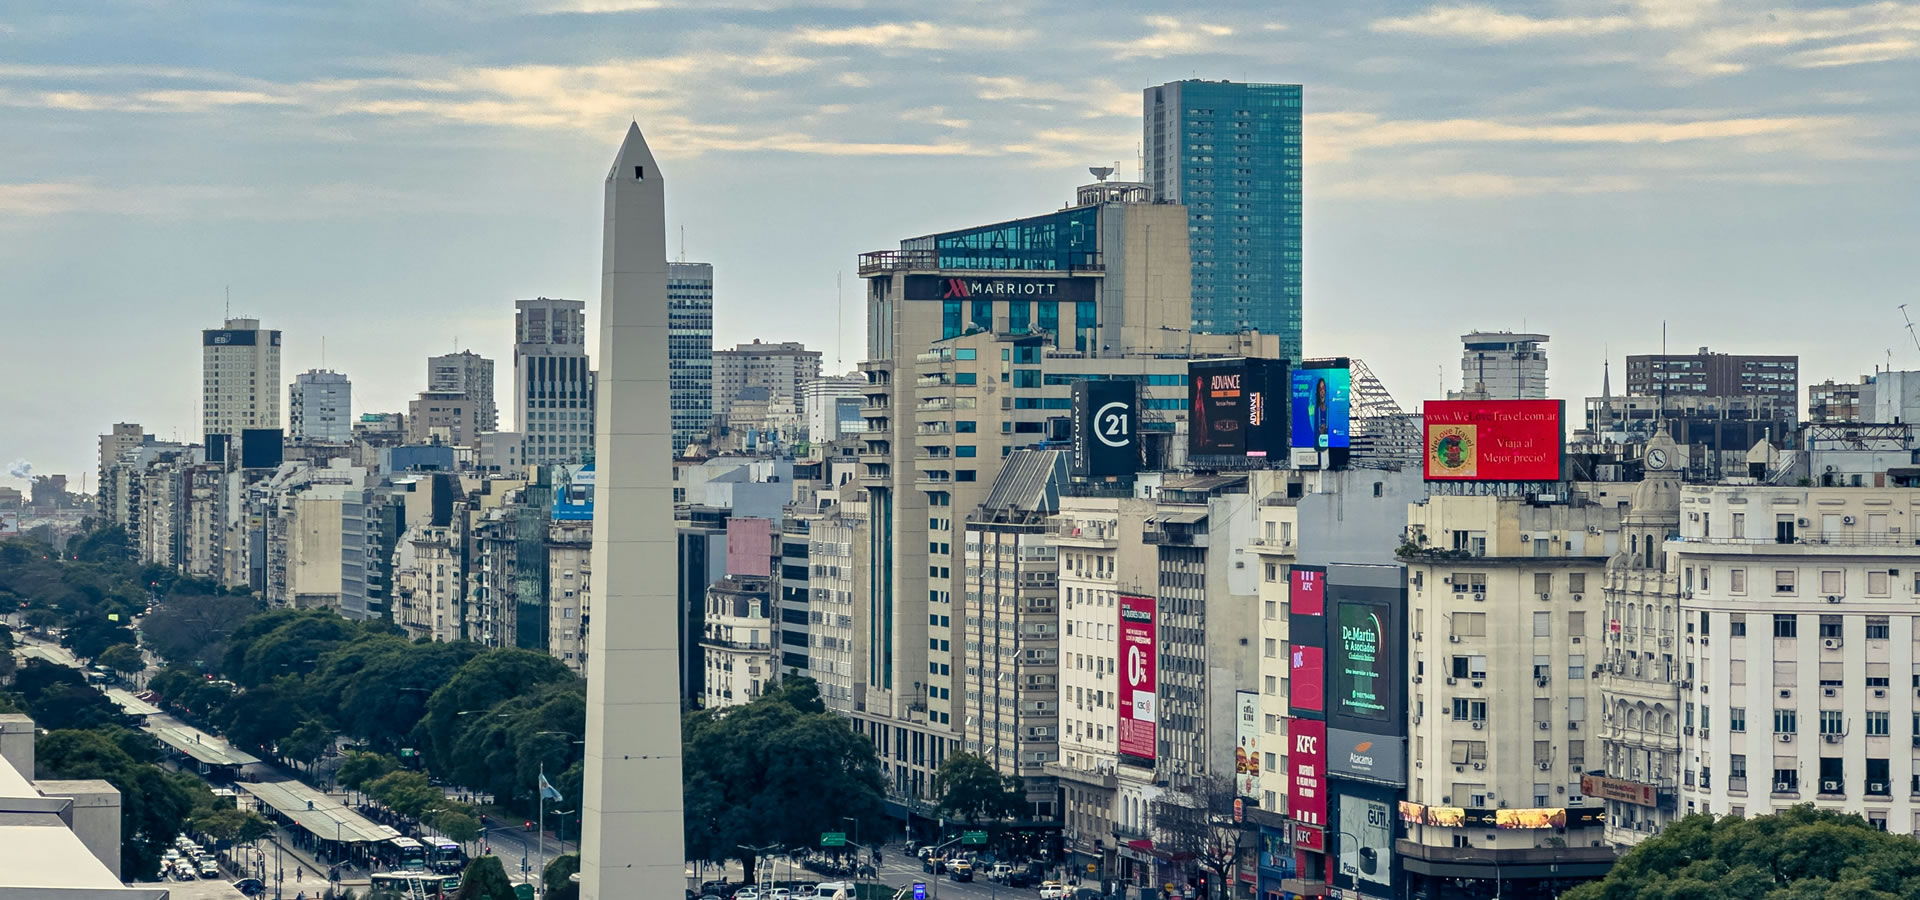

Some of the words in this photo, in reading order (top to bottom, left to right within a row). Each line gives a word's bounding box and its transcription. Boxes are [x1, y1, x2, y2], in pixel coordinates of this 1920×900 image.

[971, 284, 1056, 295] MARRIOTT
[1211, 375, 1240, 390] ADVANCE
[1075, 391, 1080, 403] 21
[1105, 414, 1129, 435] 21
[1454, 427, 1475, 448] Travel
[1497, 438, 1521, 449] Viaja
[1524, 438, 1533, 448] al
[1483, 452, 1511, 464] Mejor
[1514, 453, 1546, 464] precio!
[1302, 582, 1313, 592] KFC
[1350, 641, 1376, 653] Asociados
[1296, 735, 1317, 755] KFC
[1350, 752, 1373, 766] Atacama
[1296, 829, 1311, 844] KFC
